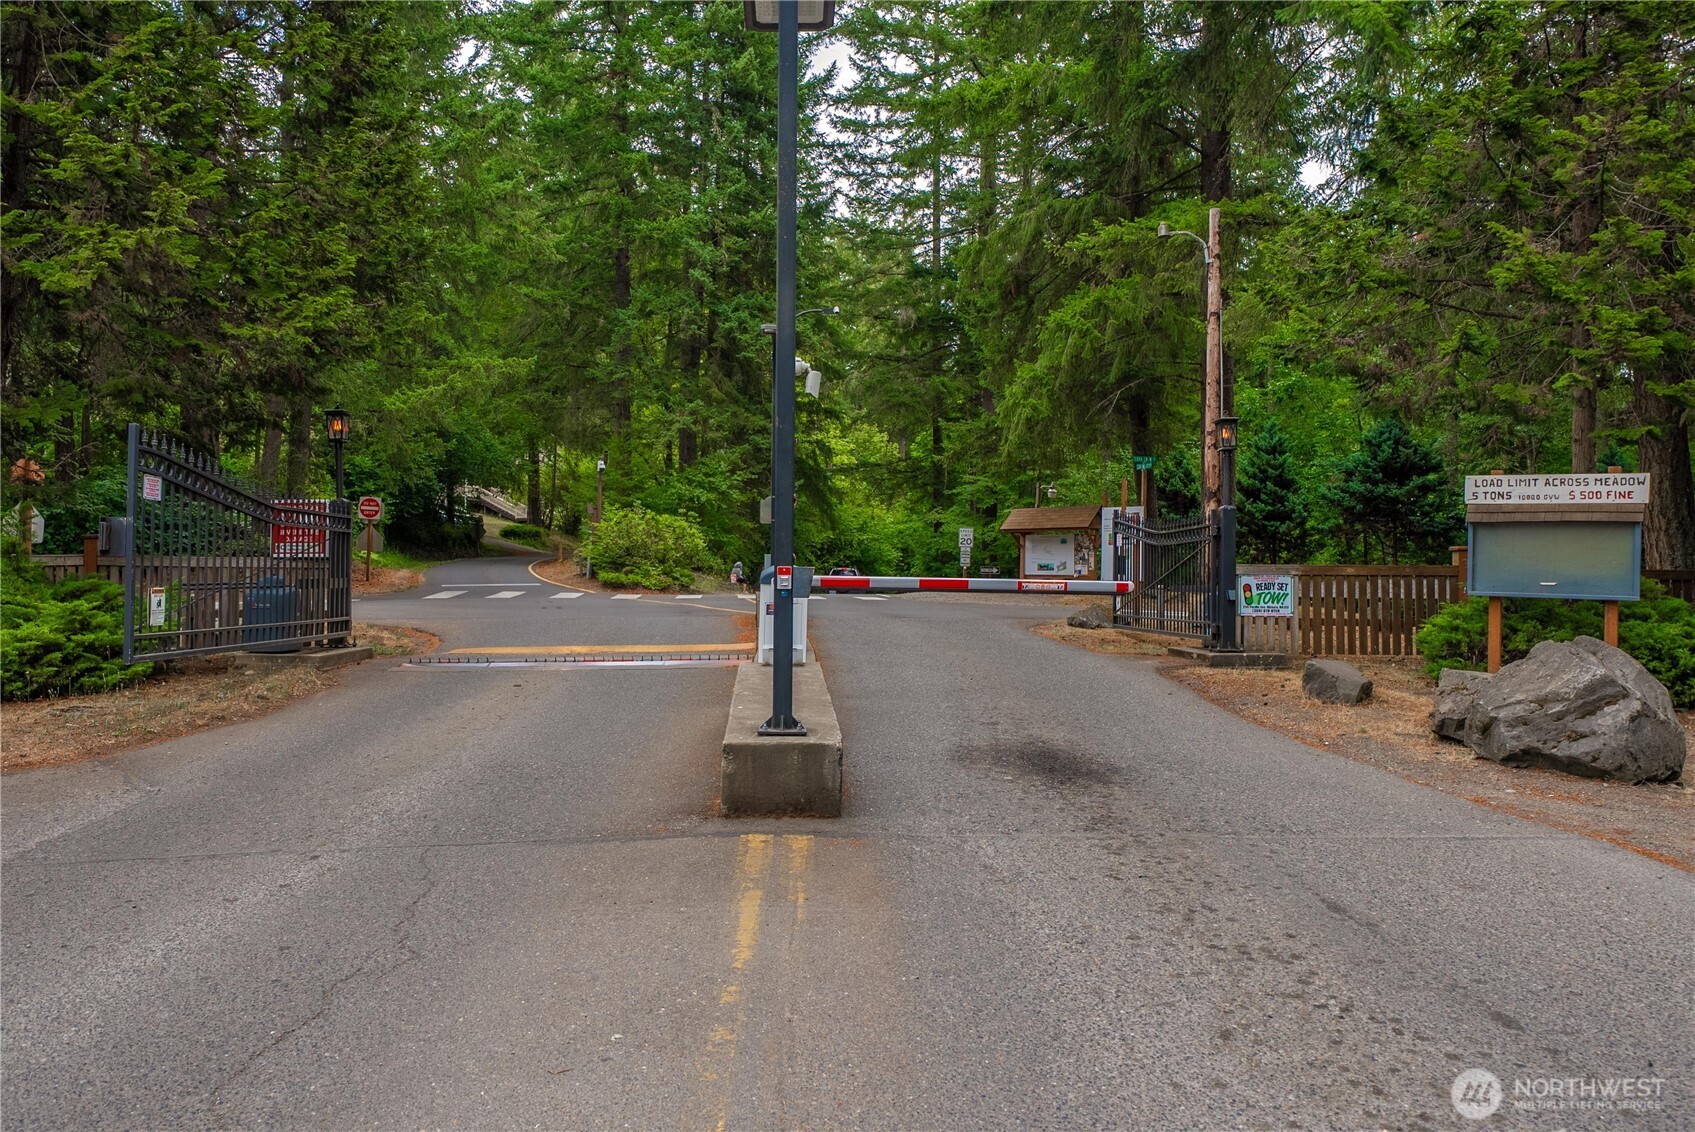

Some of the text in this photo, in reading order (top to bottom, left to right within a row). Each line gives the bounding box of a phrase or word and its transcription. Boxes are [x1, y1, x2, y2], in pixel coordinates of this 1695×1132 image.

[1474, 475, 1647, 488] LOAD LIMIT ACROSS MEADOW
[1472, 491, 1479, 500] 5
[1482, 491, 1512, 500] TONS
[1606, 490, 1634, 500] FINE
[960, 537, 972, 545] 20
[1256, 583, 1288, 591] READY SET
[1257, 592, 1289, 605] TOW!
